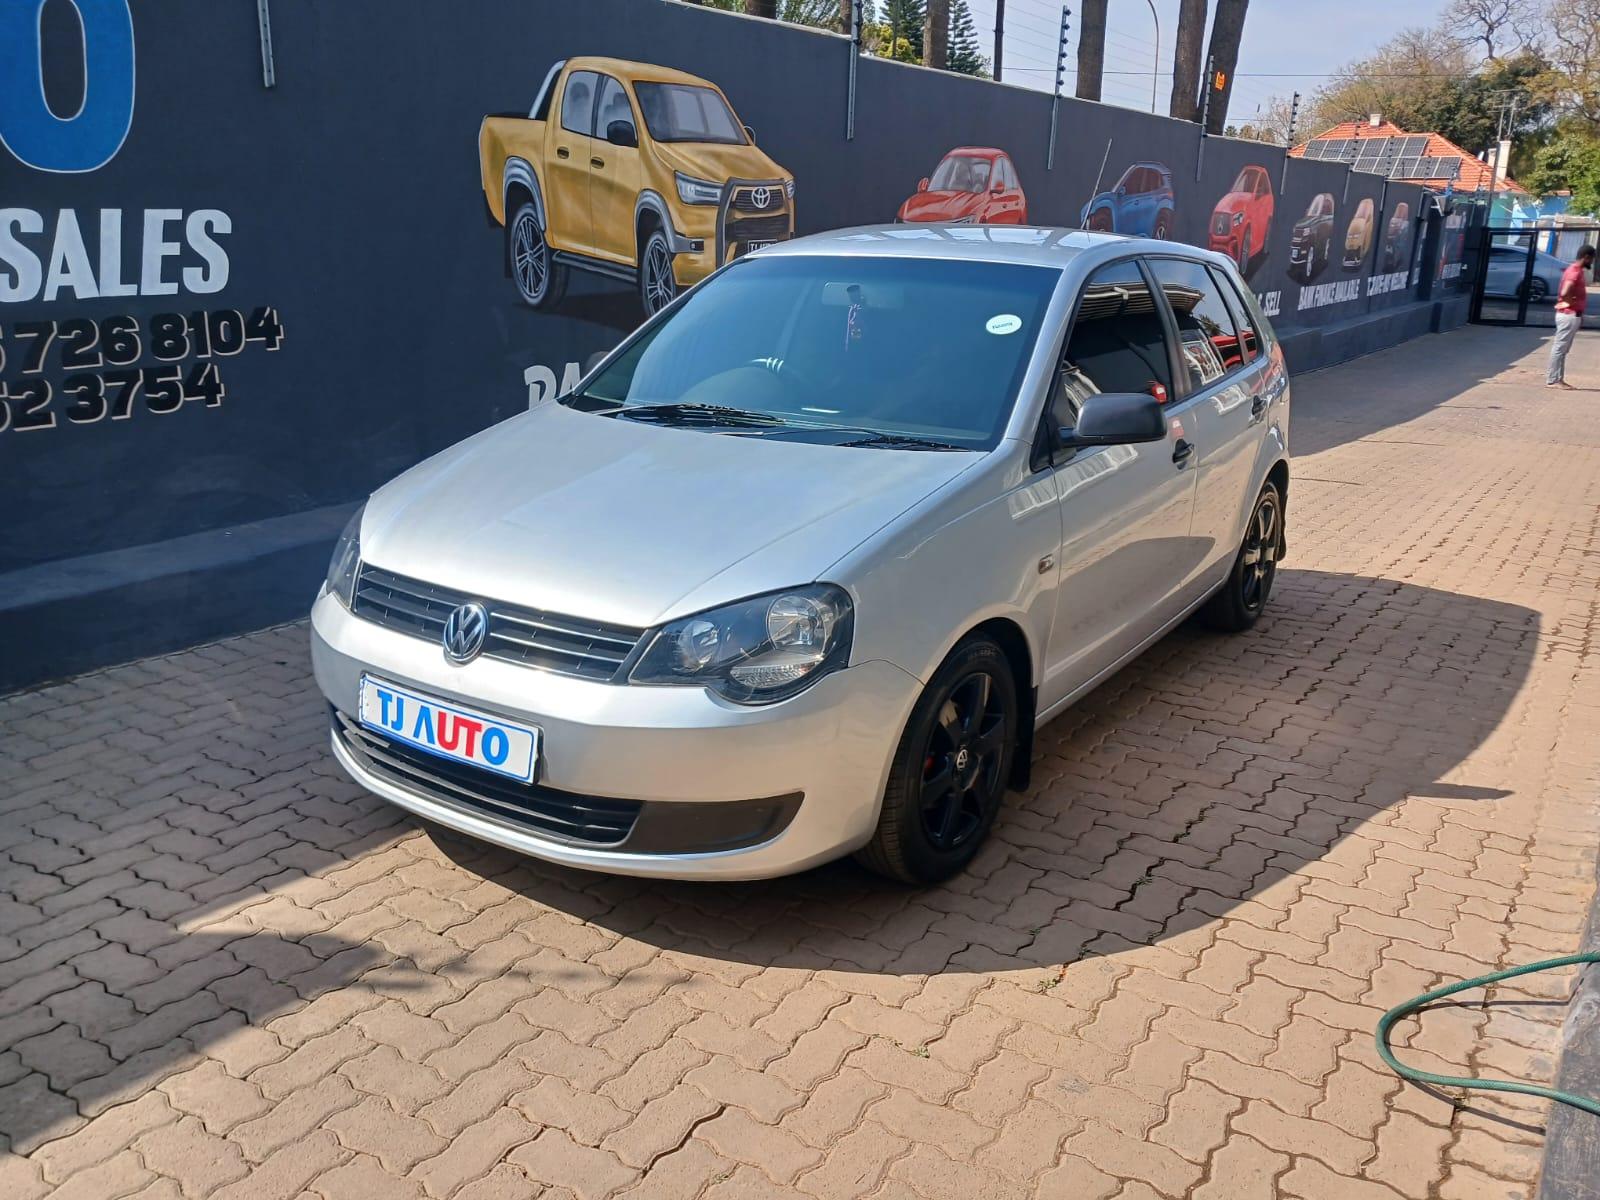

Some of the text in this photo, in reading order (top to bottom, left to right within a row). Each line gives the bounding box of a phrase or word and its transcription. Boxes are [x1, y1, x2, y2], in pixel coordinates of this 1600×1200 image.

[0, 207, 233, 302] SALES
[14, 315, 142, 374] 726
[151, 306, 285, 361] 8104
[63, 362, 225, 424] 3754
[377, 688, 509, 766] TJ AUTO
